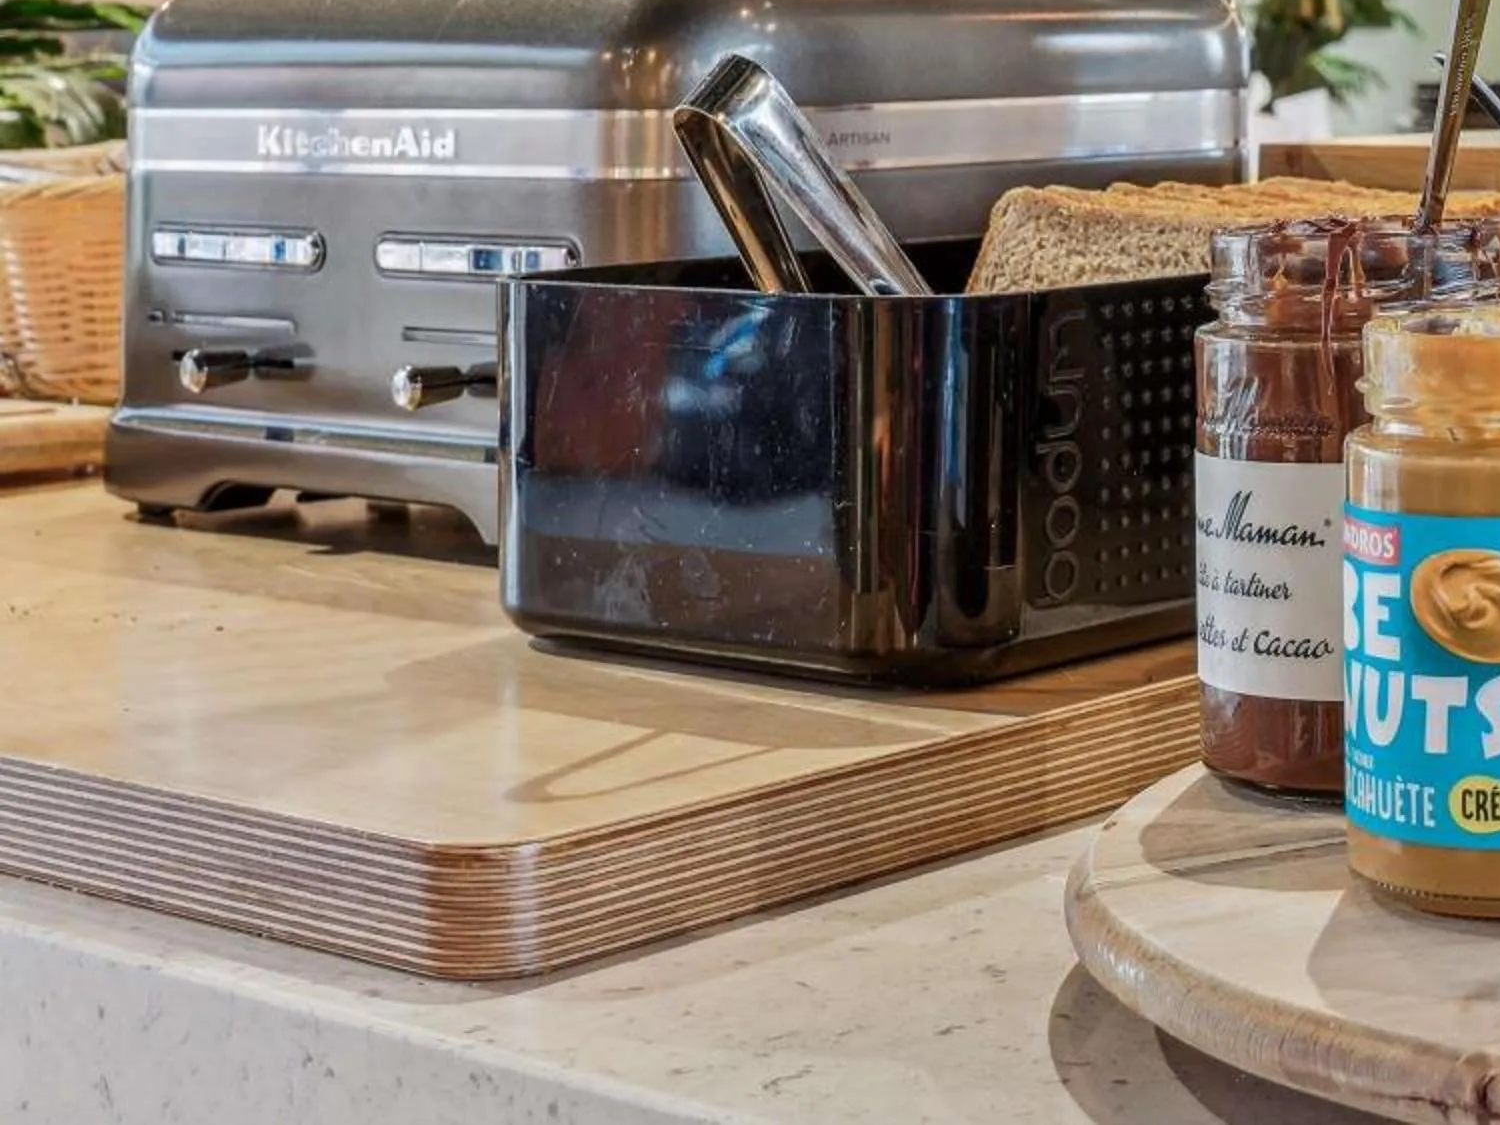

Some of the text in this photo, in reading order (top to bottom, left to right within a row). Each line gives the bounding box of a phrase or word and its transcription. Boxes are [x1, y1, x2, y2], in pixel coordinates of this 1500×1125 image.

[257, 124, 456, 159] KitchenAid
[826, 131, 891, 148] ARTISAN
[1223, 570, 1293, 601] tartiner
[1231, 627, 1249, 653] et
[1253, 629, 1335, 660] Cacao
